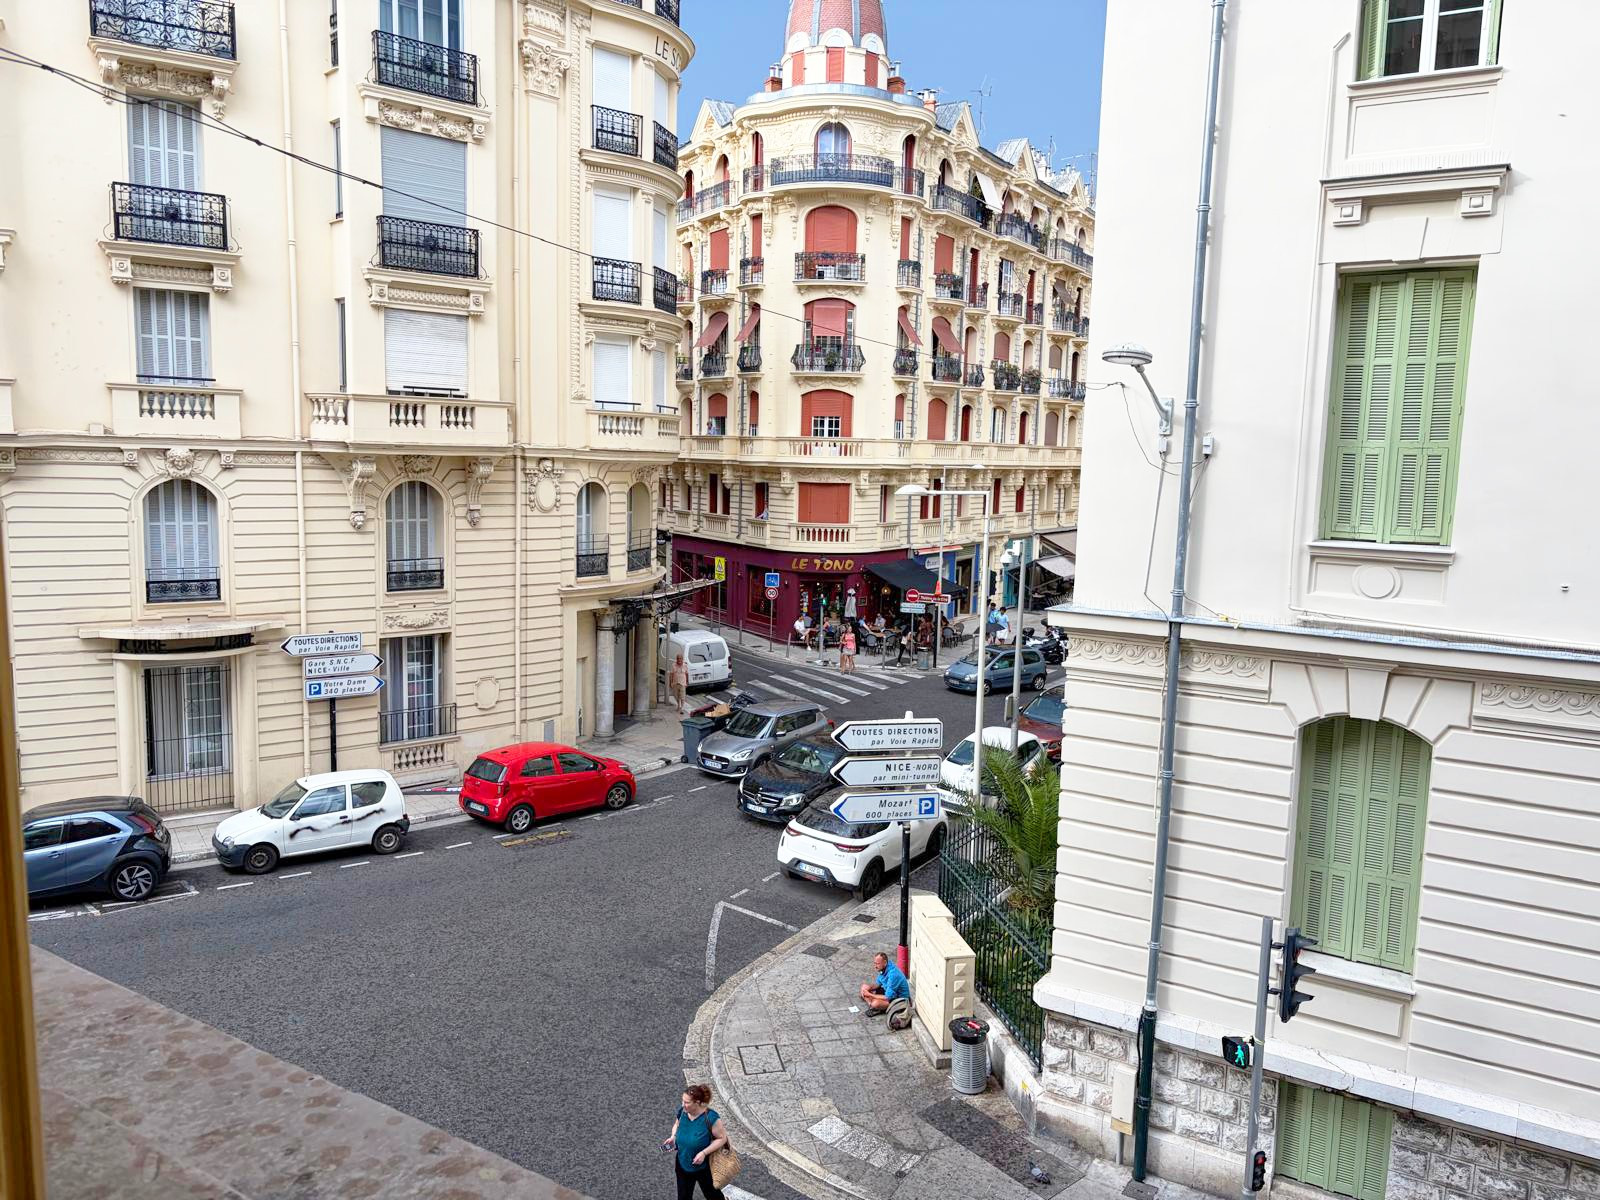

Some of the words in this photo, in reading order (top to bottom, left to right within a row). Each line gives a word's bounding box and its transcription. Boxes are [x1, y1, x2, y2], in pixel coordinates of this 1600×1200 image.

[655, 35, 669, 60] LE
[791, 558, 808, 570] LE
[294, 637, 319, 646] TOUTES
[320, 634, 359, 644] DIRECTIONS
[334, 643, 359, 652] Rapide
[308, 660, 326, 668] Gare
[310, 684, 319, 695] P
[324, 687, 339, 695] 340
[341, 686, 366, 694] places
[887, 727, 939, 735] DIRECTIONS
[911, 737, 939, 745] Rapide
[872, 775, 886, 783] par
[878, 799, 913, 808] Mozart
[921, 799, 932, 814] P
[865, 811, 882, 819] 600
[886, 811, 912, 819] places
